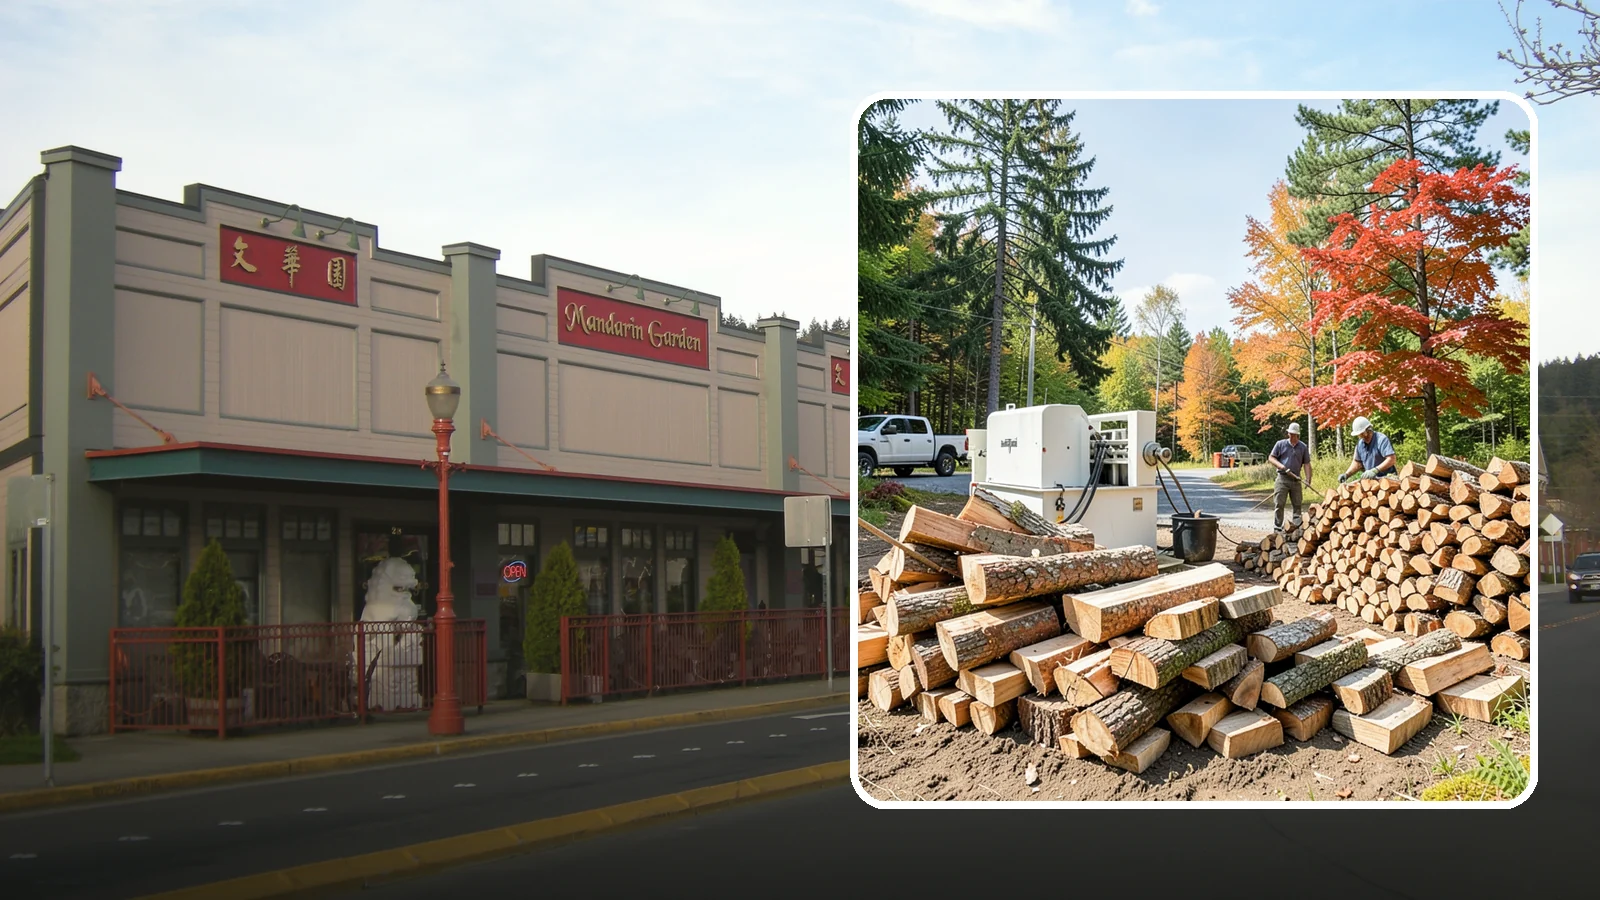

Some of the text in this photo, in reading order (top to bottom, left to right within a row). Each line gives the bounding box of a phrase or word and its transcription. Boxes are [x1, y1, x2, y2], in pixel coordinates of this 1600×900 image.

[231, 235, 346, 291] 文華園
[564, 302, 702, 352] Mandarin Garden
[834, 363, 846, 386] 文
[503, 565, 527, 578] OPEN
